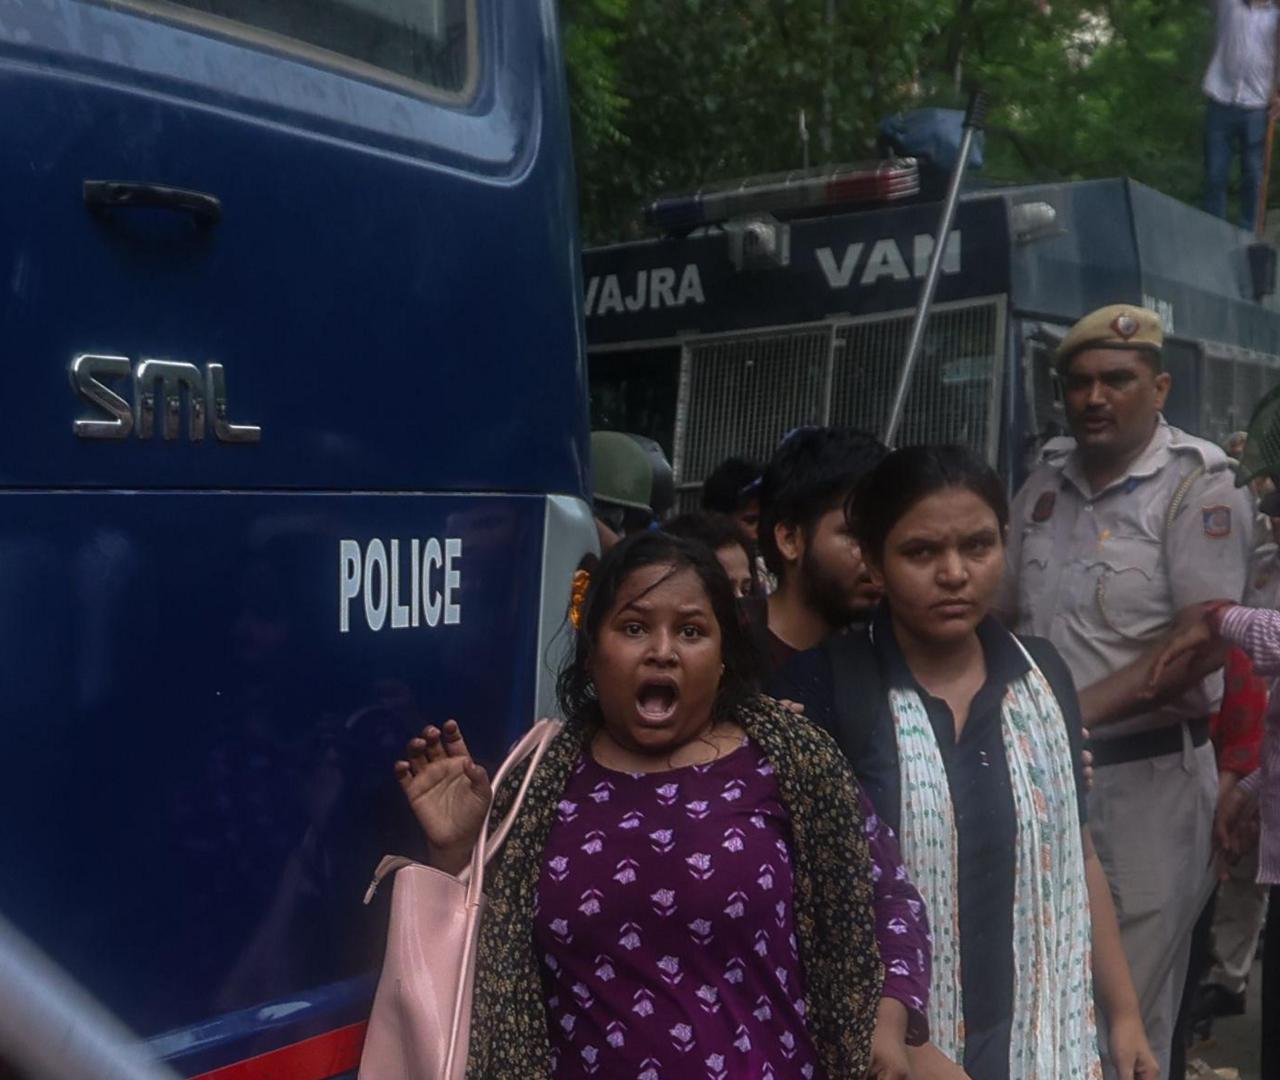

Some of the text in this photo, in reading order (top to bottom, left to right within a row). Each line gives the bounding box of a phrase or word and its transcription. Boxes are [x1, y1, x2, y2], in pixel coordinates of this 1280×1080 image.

[815, 229, 961, 290] VAN
[70, 354, 261, 443] SML
[339, 537, 462, 633] POLICE
